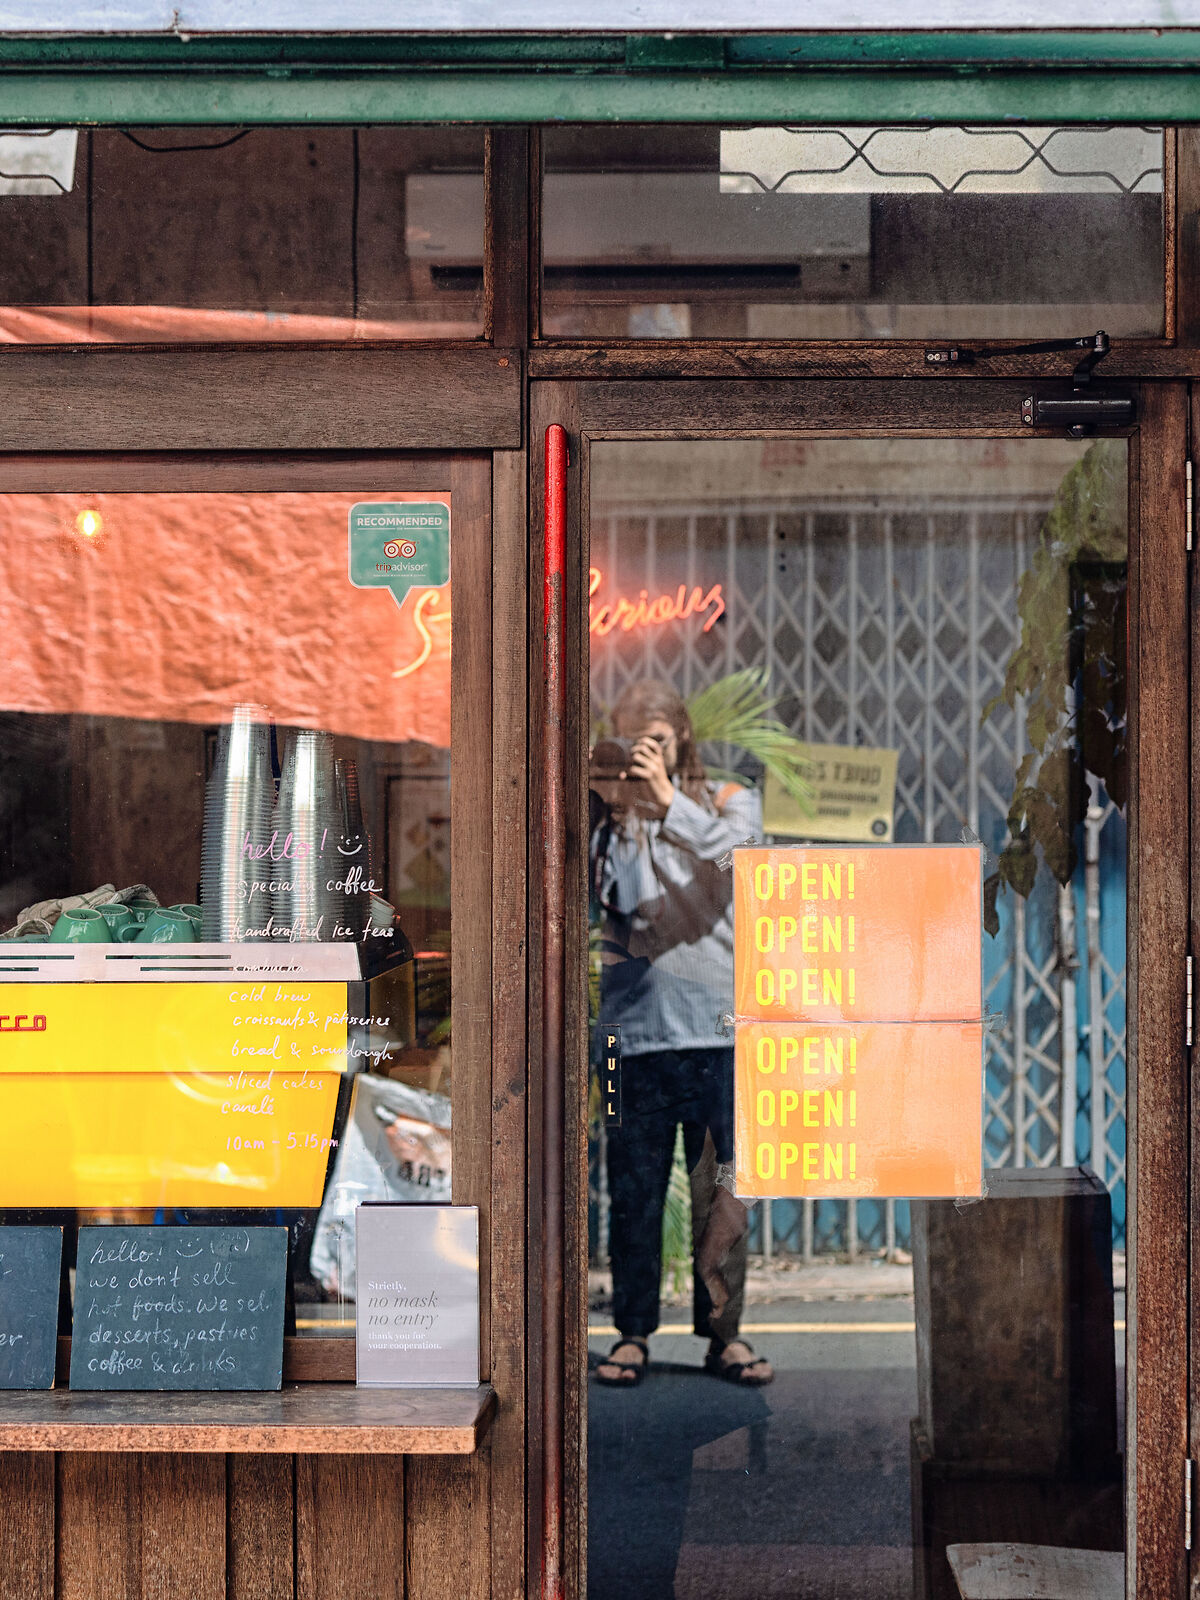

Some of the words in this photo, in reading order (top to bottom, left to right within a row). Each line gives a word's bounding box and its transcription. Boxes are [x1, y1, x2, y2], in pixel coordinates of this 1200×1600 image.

[357, 517, 442, 526] RECOMMENDED
[240, 828, 328, 861] hello!
[326, 866, 383, 894] coffee
[755, 863, 856, 900] OPEN!
[333, 920, 354, 938] ice
[362, 916, 394, 941] teas
[755, 916, 856, 953] OPEN!
[229, 985, 266, 1003] cold
[274, 985, 311, 1002] brew
[755, 968, 856, 1006] OPEN!
[233, 1007, 304, 1031] croissants
[307, 1011, 320, 1027] &
[231, 1035, 282, 1060] bread
[290, 1042, 301, 1059] &
[311, 1039, 394, 1066] sourdough
[757, 1036, 857, 1074] OPEN!
[226, 1069, 274, 1091] sliced
[282, 1069, 324, 1091] cakes
[607, 1034, 616, 1116] PULL
[757, 1089, 857, 1127] OPEN!
[226, 1136, 265, 1151] 10am
[286, 1131, 340, 1153] 5.15pm
[757, 1142, 857, 1180] OPEN!
[90, 1239, 164, 1264] hello!
[89, 1276, 119, 1289] we
[129, 1265, 179, 1289] don't
[193, 1262, 237, 1288] sell
[88, 1295, 122, 1318] hot
[197, 1296, 228, 1314] We
[368, 1297, 388, 1308] no
[394, 1290, 438, 1308] mask
[368, 1315, 388, 1325] no
[394, 1313, 439, 1330] entry
[368, 1331, 393, 1340] thank
[394, 1333, 410, 1342] you
[413, 1331, 426, 1340] for
[368, 1343, 388, 1352] your
[88, 1349, 143, 1375] coffee
[151, 1352, 166, 1374] &
